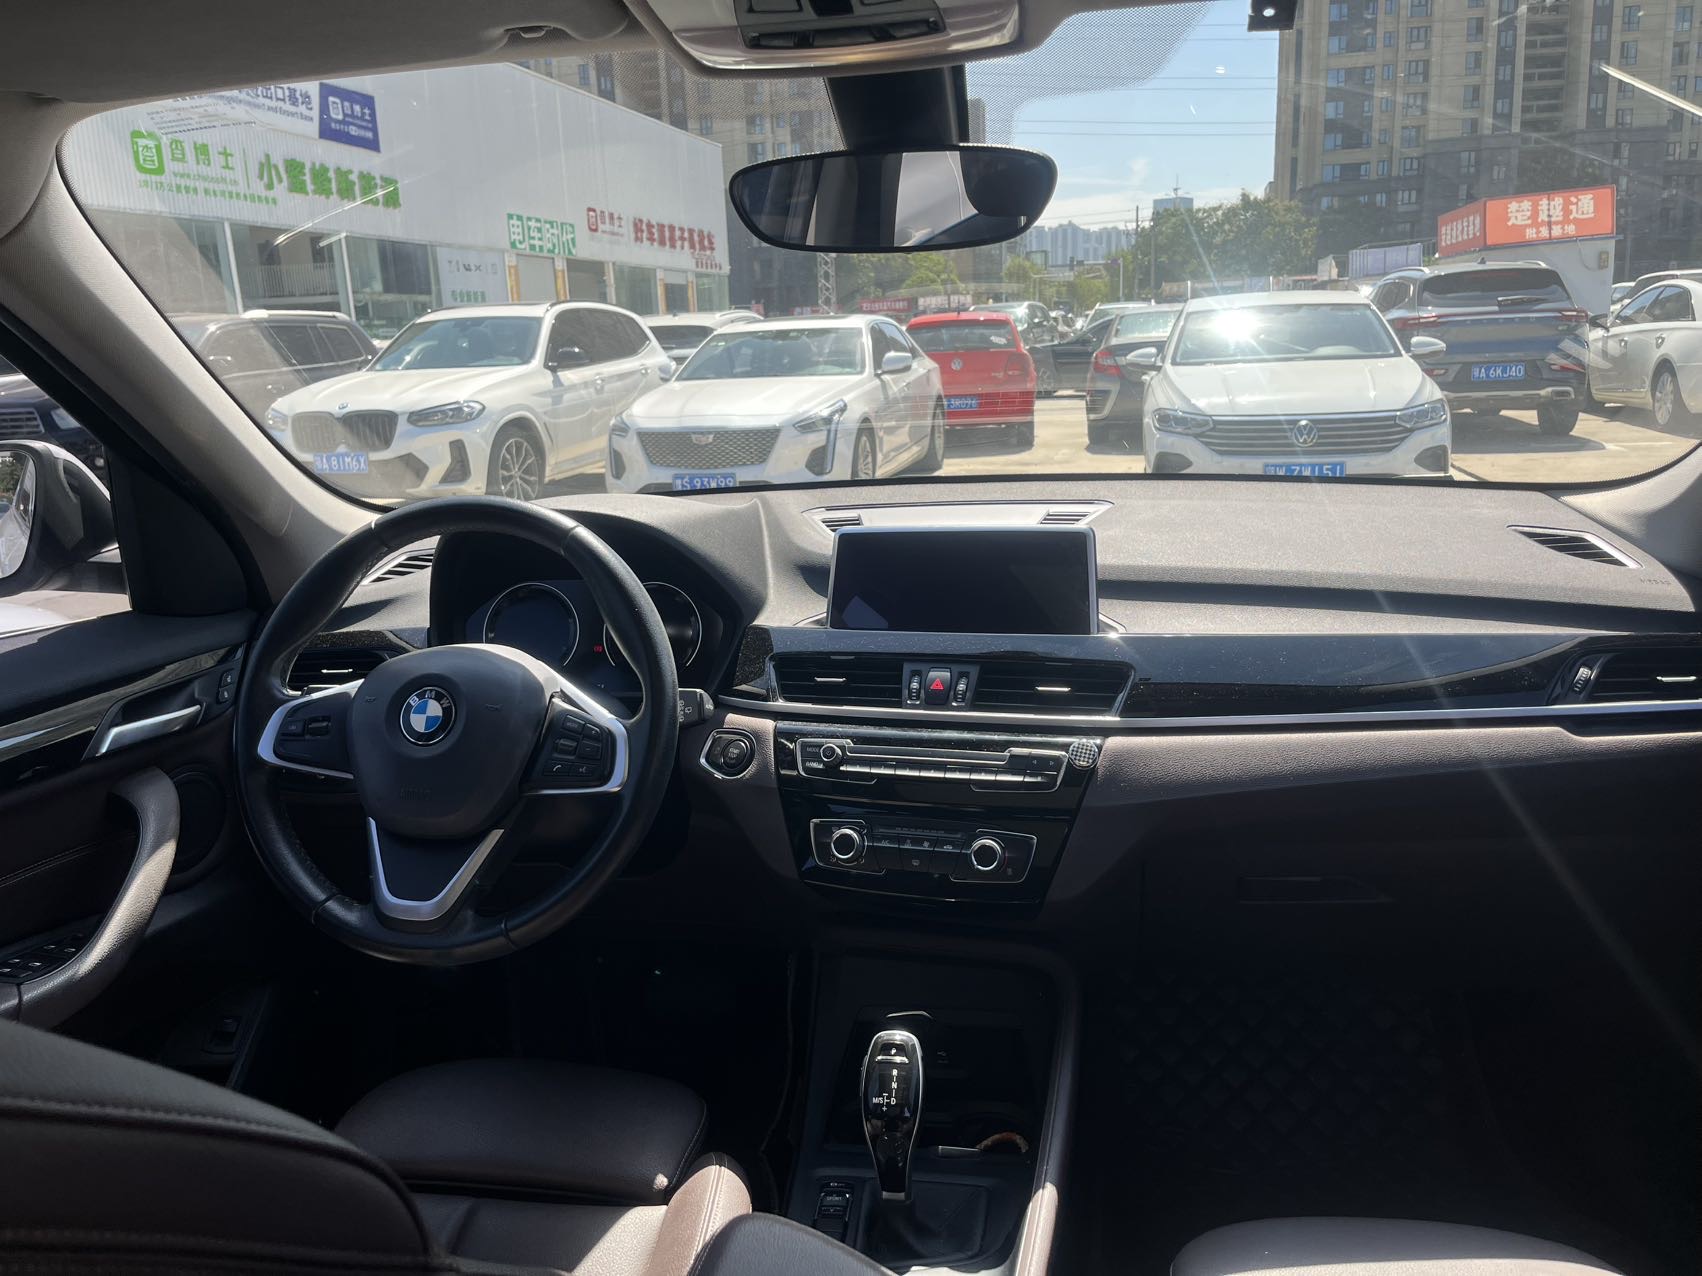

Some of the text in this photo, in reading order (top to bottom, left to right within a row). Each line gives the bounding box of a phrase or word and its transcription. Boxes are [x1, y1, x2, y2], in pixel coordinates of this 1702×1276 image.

[1507, 194, 1595, 226] 楚越通
[1526, 223, 1576, 239] 批发基地
[508, 214, 576, 257] 电车时代
[890, 1047, 897, 1055] P
[892, 1068, 898, 1076] R
[891, 1081, 898, 1089] N
[890, 1097, 897, 1105] D
